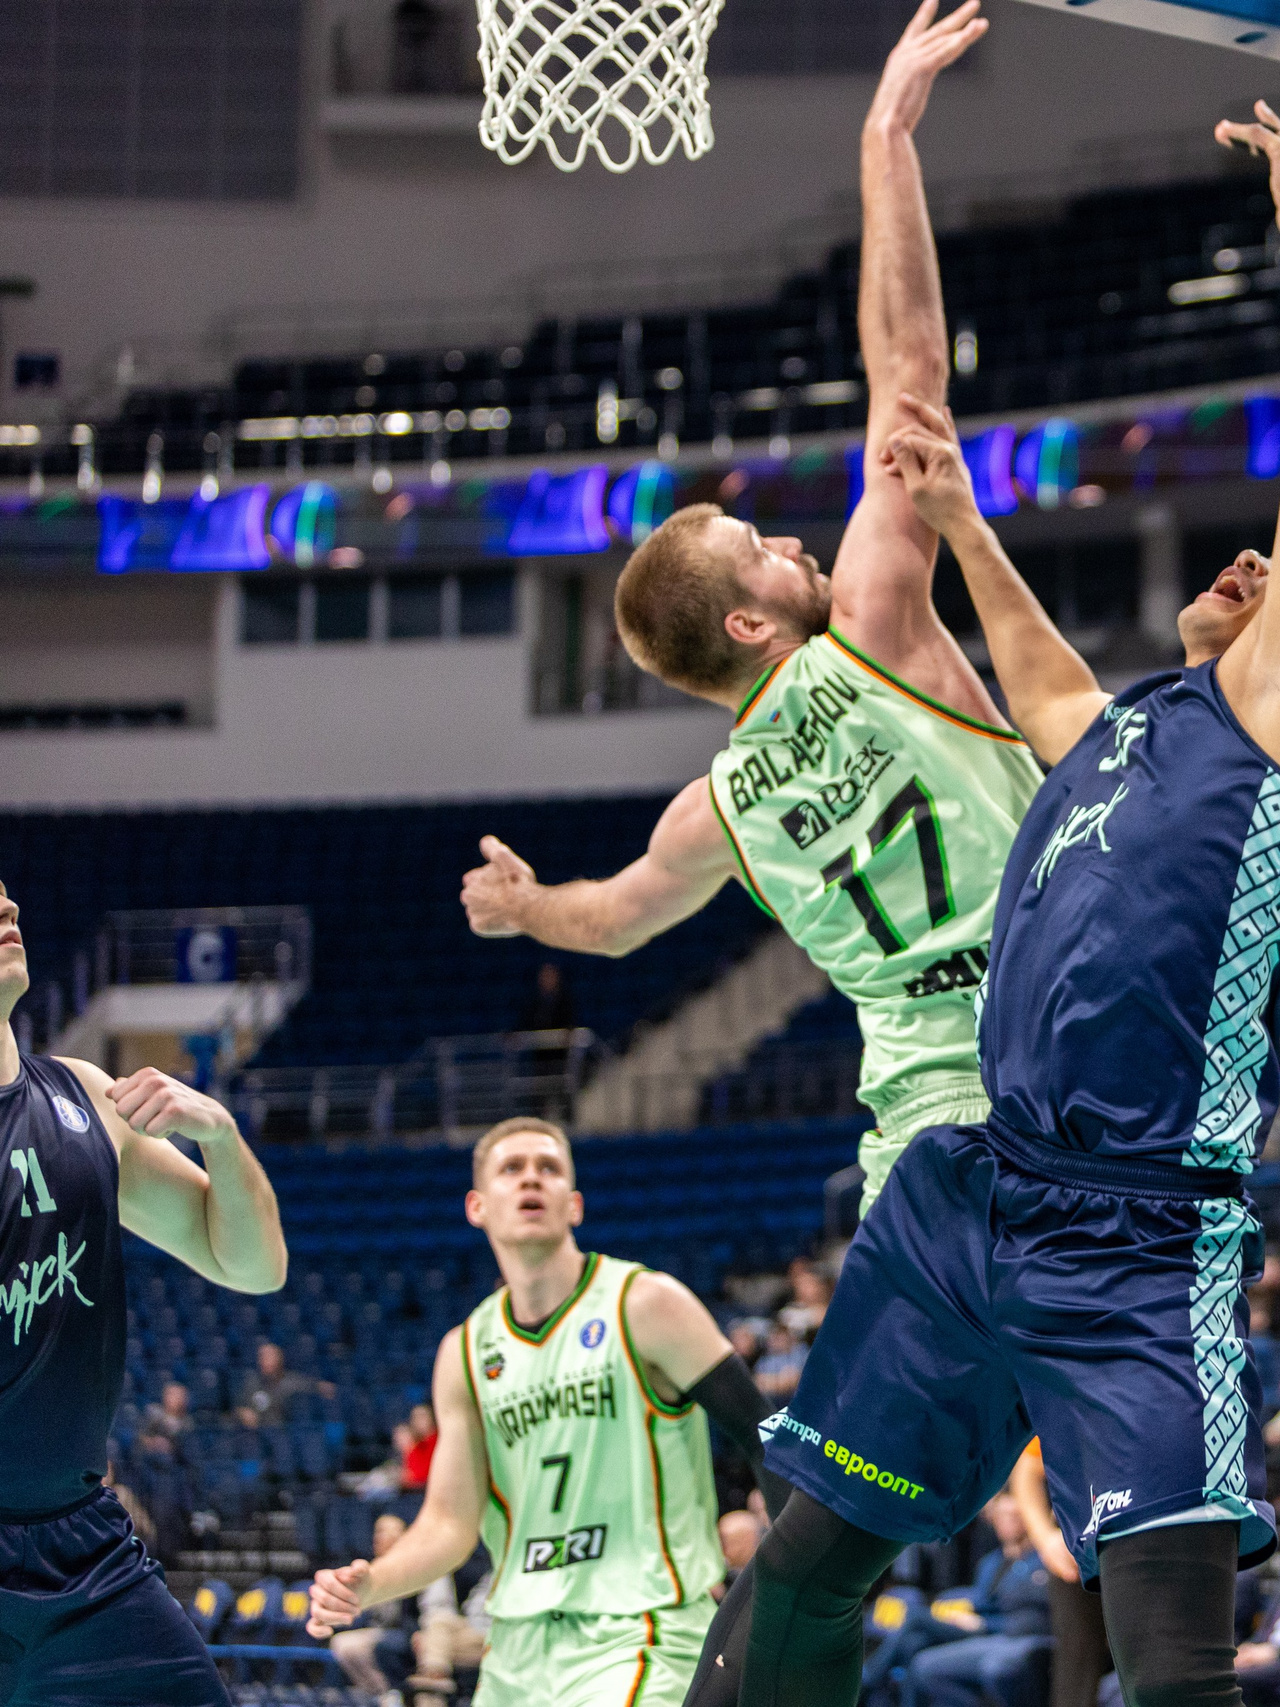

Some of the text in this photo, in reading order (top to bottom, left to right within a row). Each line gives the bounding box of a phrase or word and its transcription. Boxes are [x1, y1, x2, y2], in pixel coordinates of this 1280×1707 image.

[728, 670, 861, 816] BALASHOV
[820, 774, 957, 959] 17
[541, 1453, 572, 1513] 7
[823, 1439, 925, 1499] евроопт
